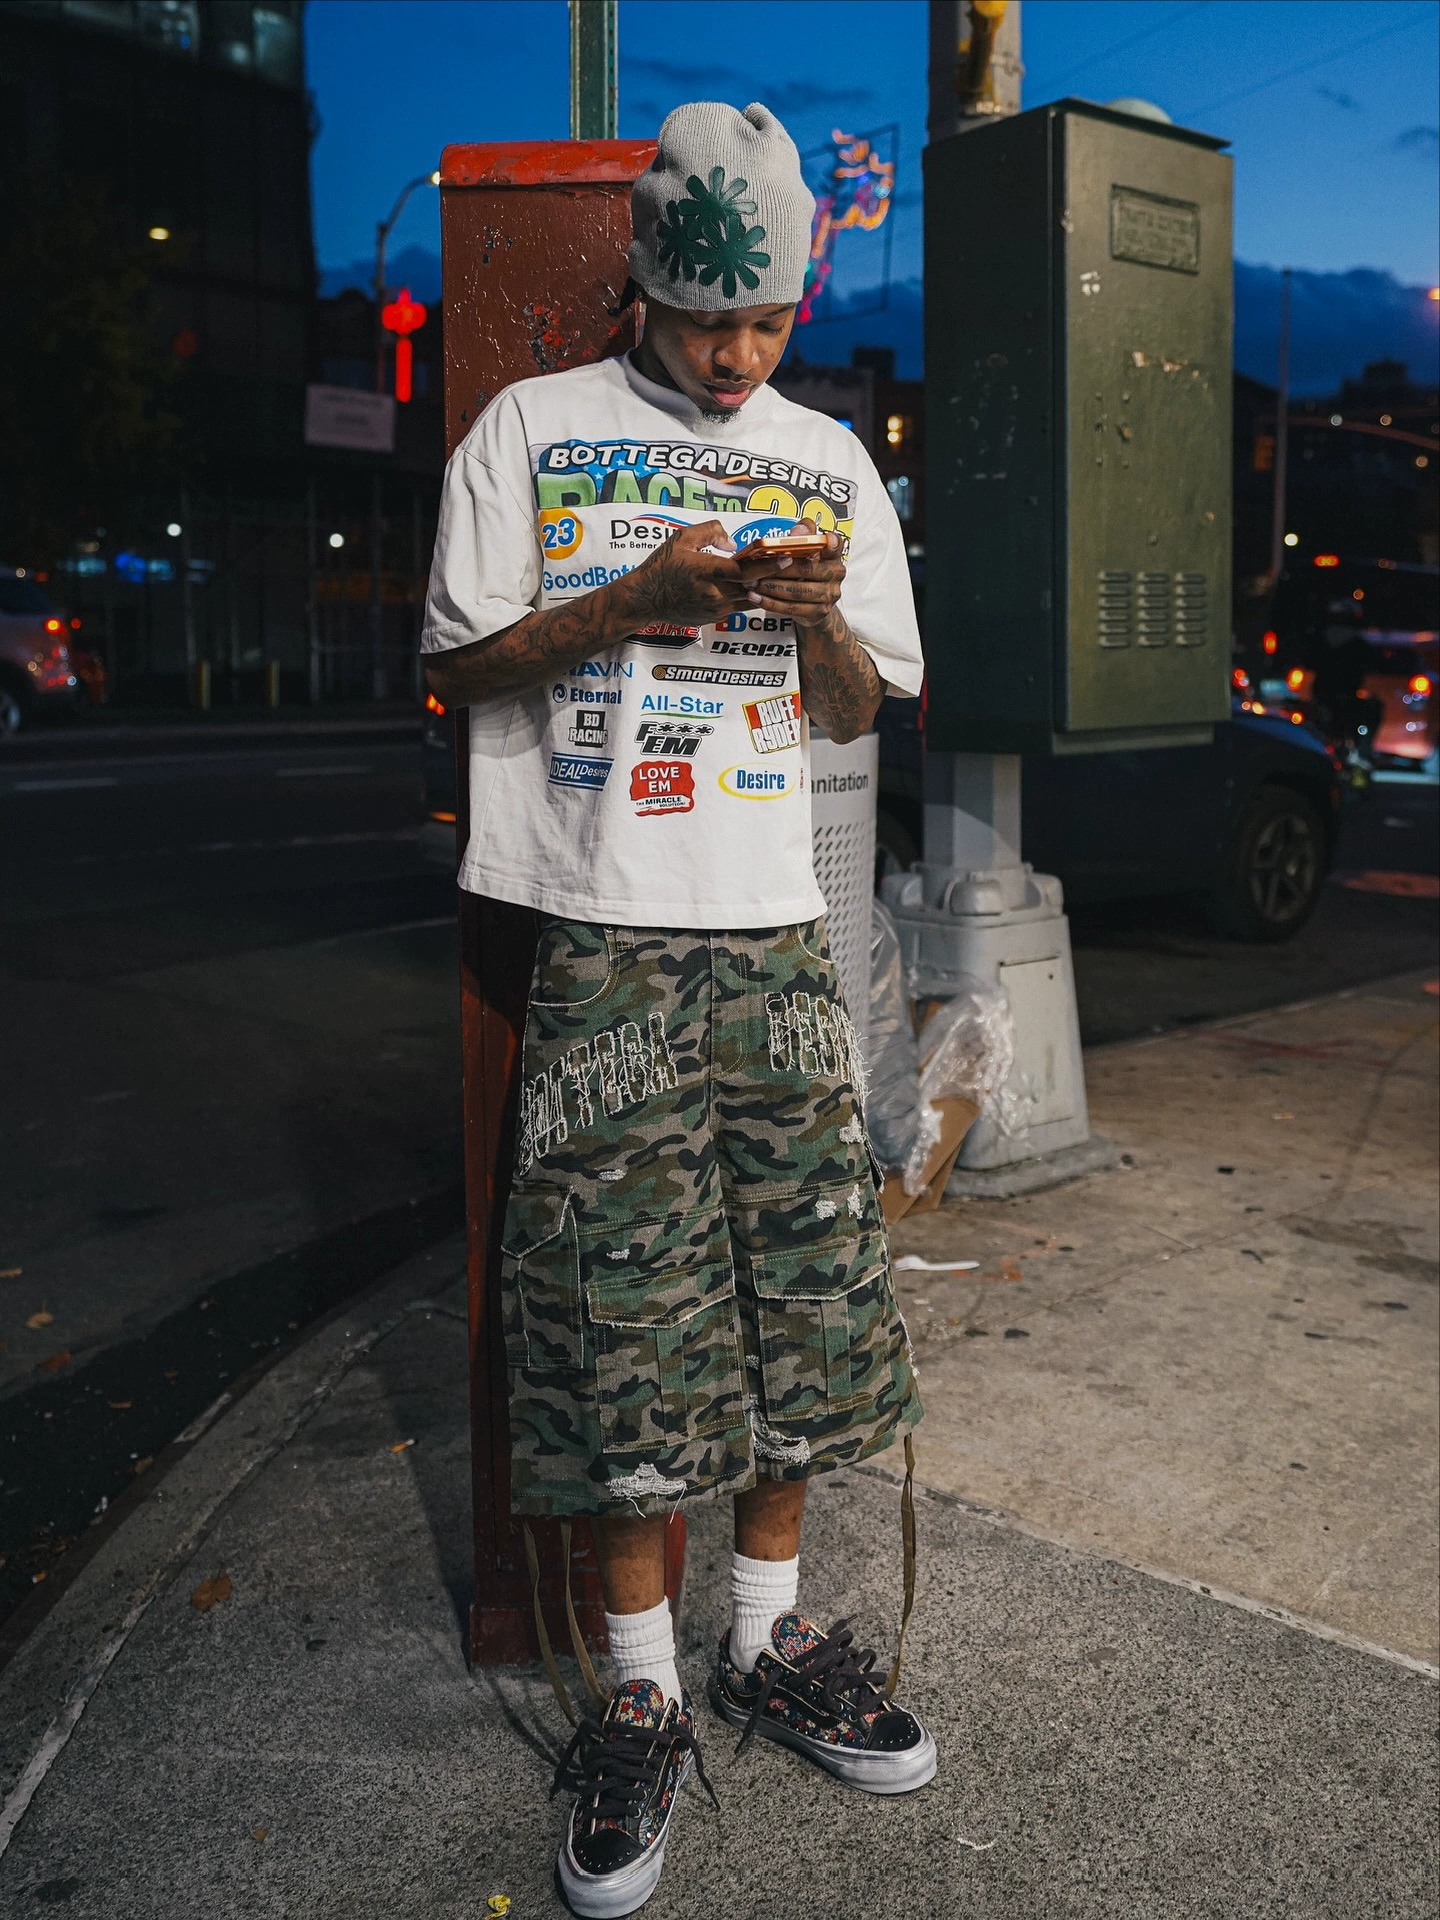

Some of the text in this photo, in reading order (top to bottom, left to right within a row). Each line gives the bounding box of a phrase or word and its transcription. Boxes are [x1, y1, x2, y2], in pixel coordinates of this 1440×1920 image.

[548, 444, 850, 503] BOTTEGA DESIRES
[542, 517, 577, 549] 23
[609, 541, 657, 549] The Better
[664, 666, 785, 687] SmartDesires
[570, 687, 622, 704] Eternal
[641, 694, 724, 714] All-Star
[583, 713, 600, 727] BD
[755, 694, 796, 727] RUFF
[569, 727, 608, 745] RACING
[641, 735, 701, 755] EM
[639, 766, 680, 780] LOVE
[736, 769, 785, 790] Desire
[648, 780, 671, 793] EM
[645, 795, 682, 805] MIRACLE
